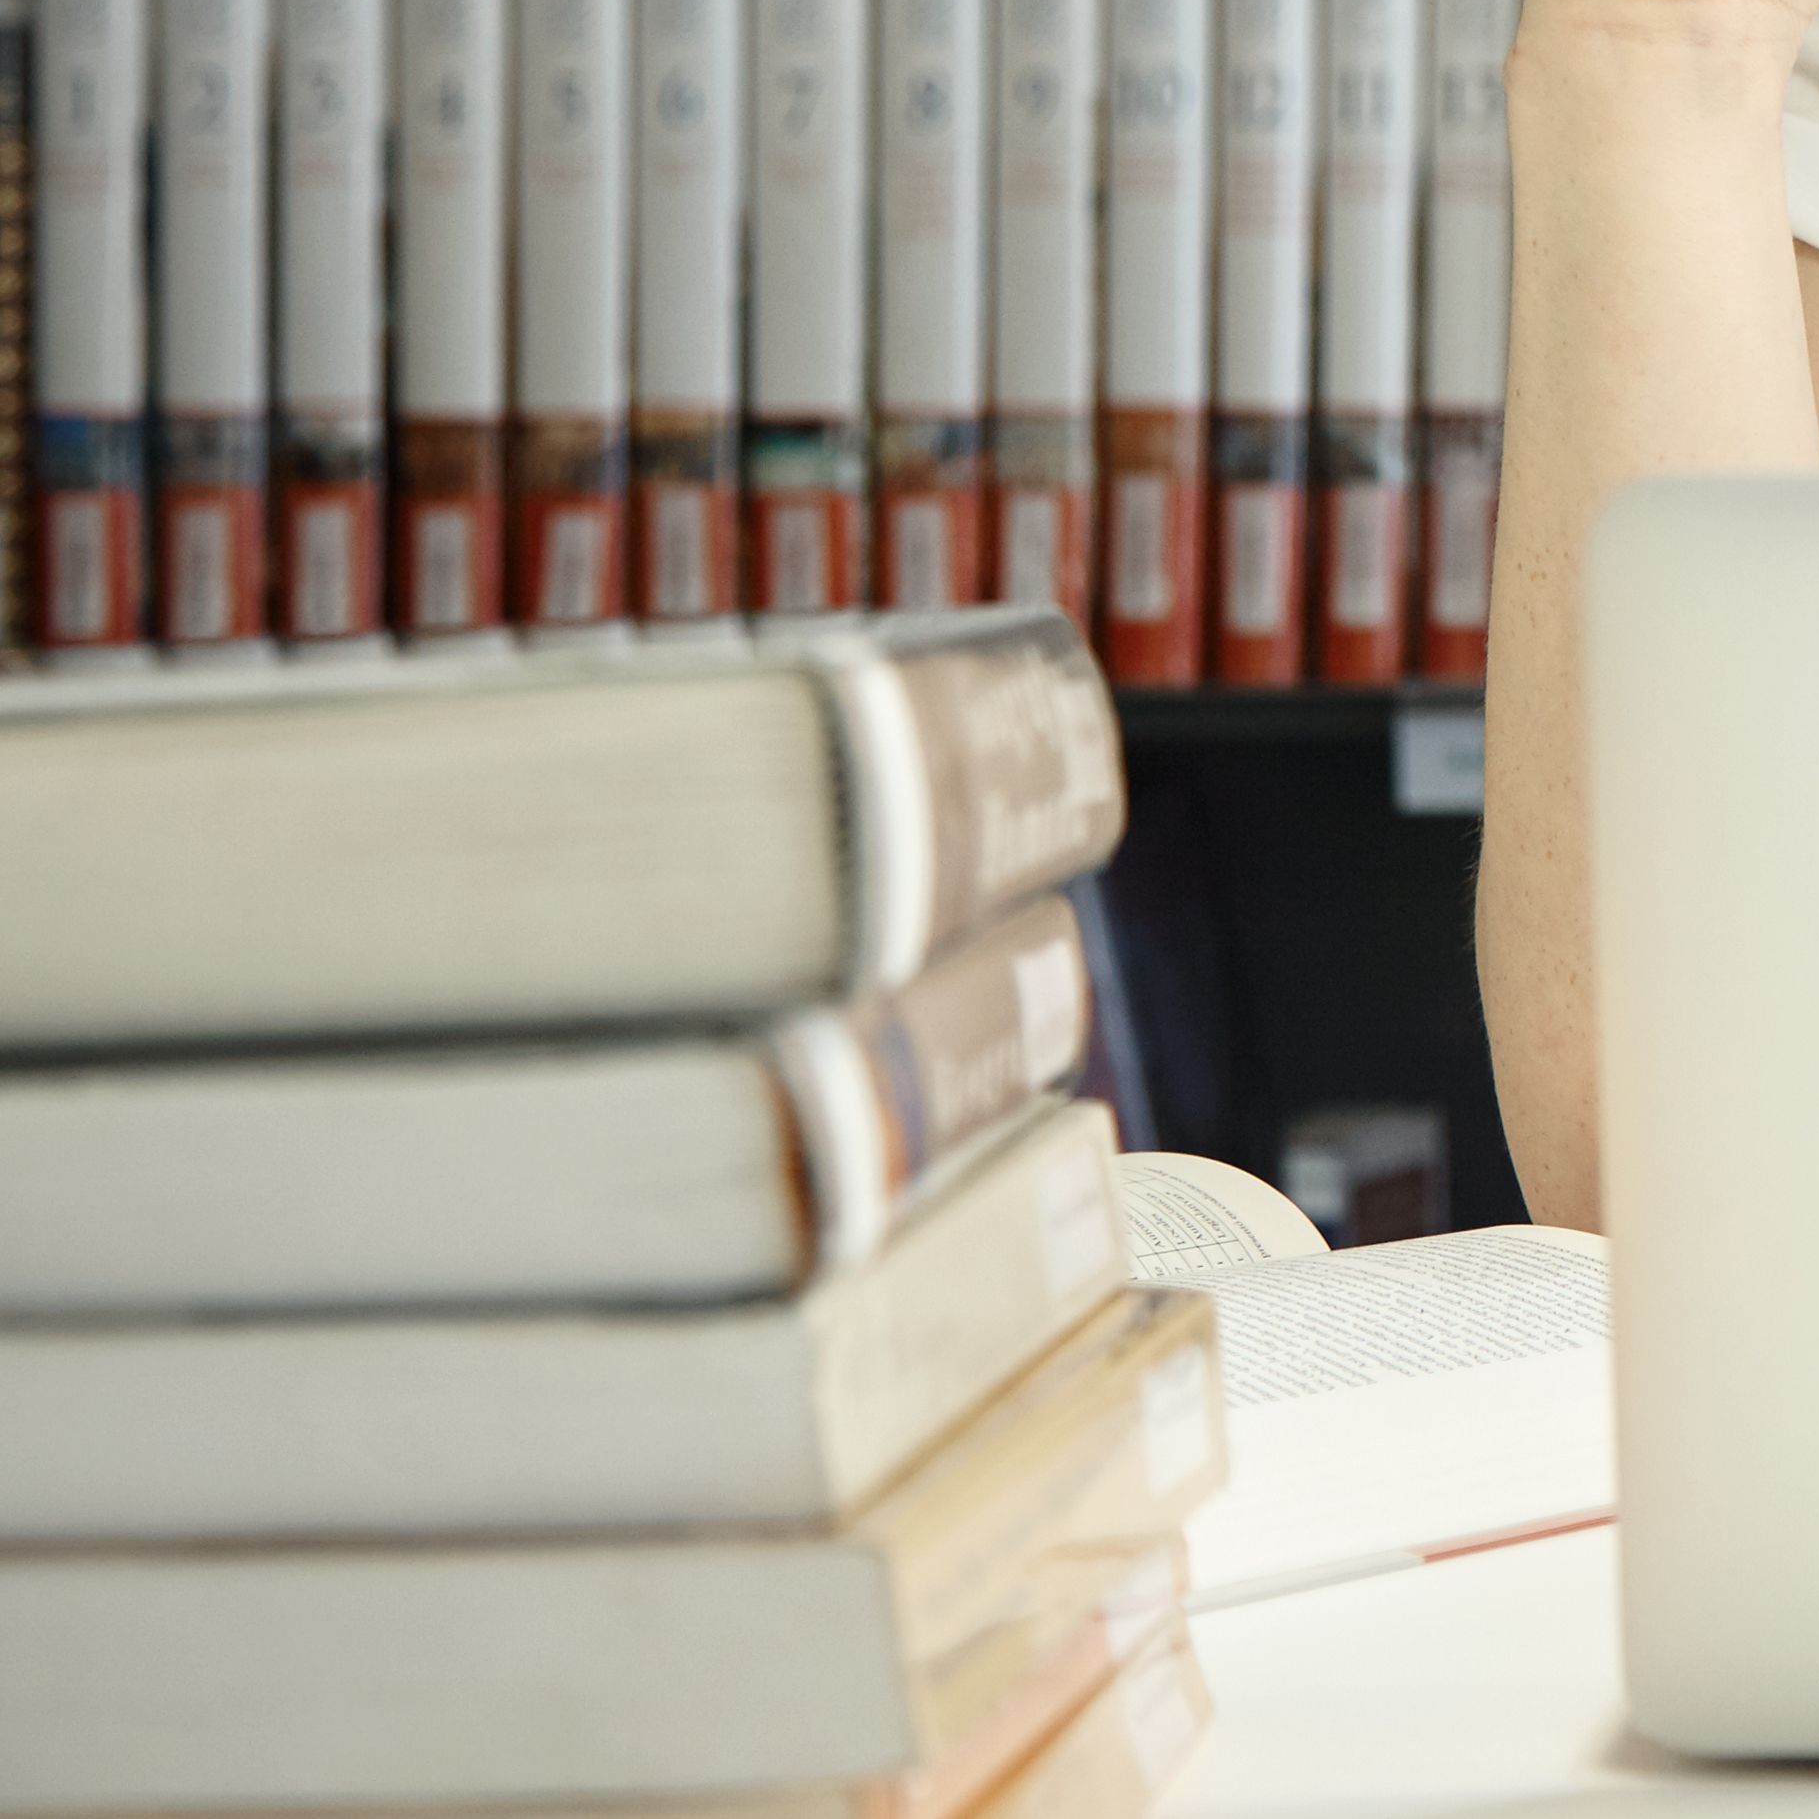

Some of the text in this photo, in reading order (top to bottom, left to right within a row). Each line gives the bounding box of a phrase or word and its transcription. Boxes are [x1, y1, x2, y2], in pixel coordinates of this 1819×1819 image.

[195, 61, 231, 133] 2
[655, 61, 705, 131] 6
[776, 65, 820, 139] 7
